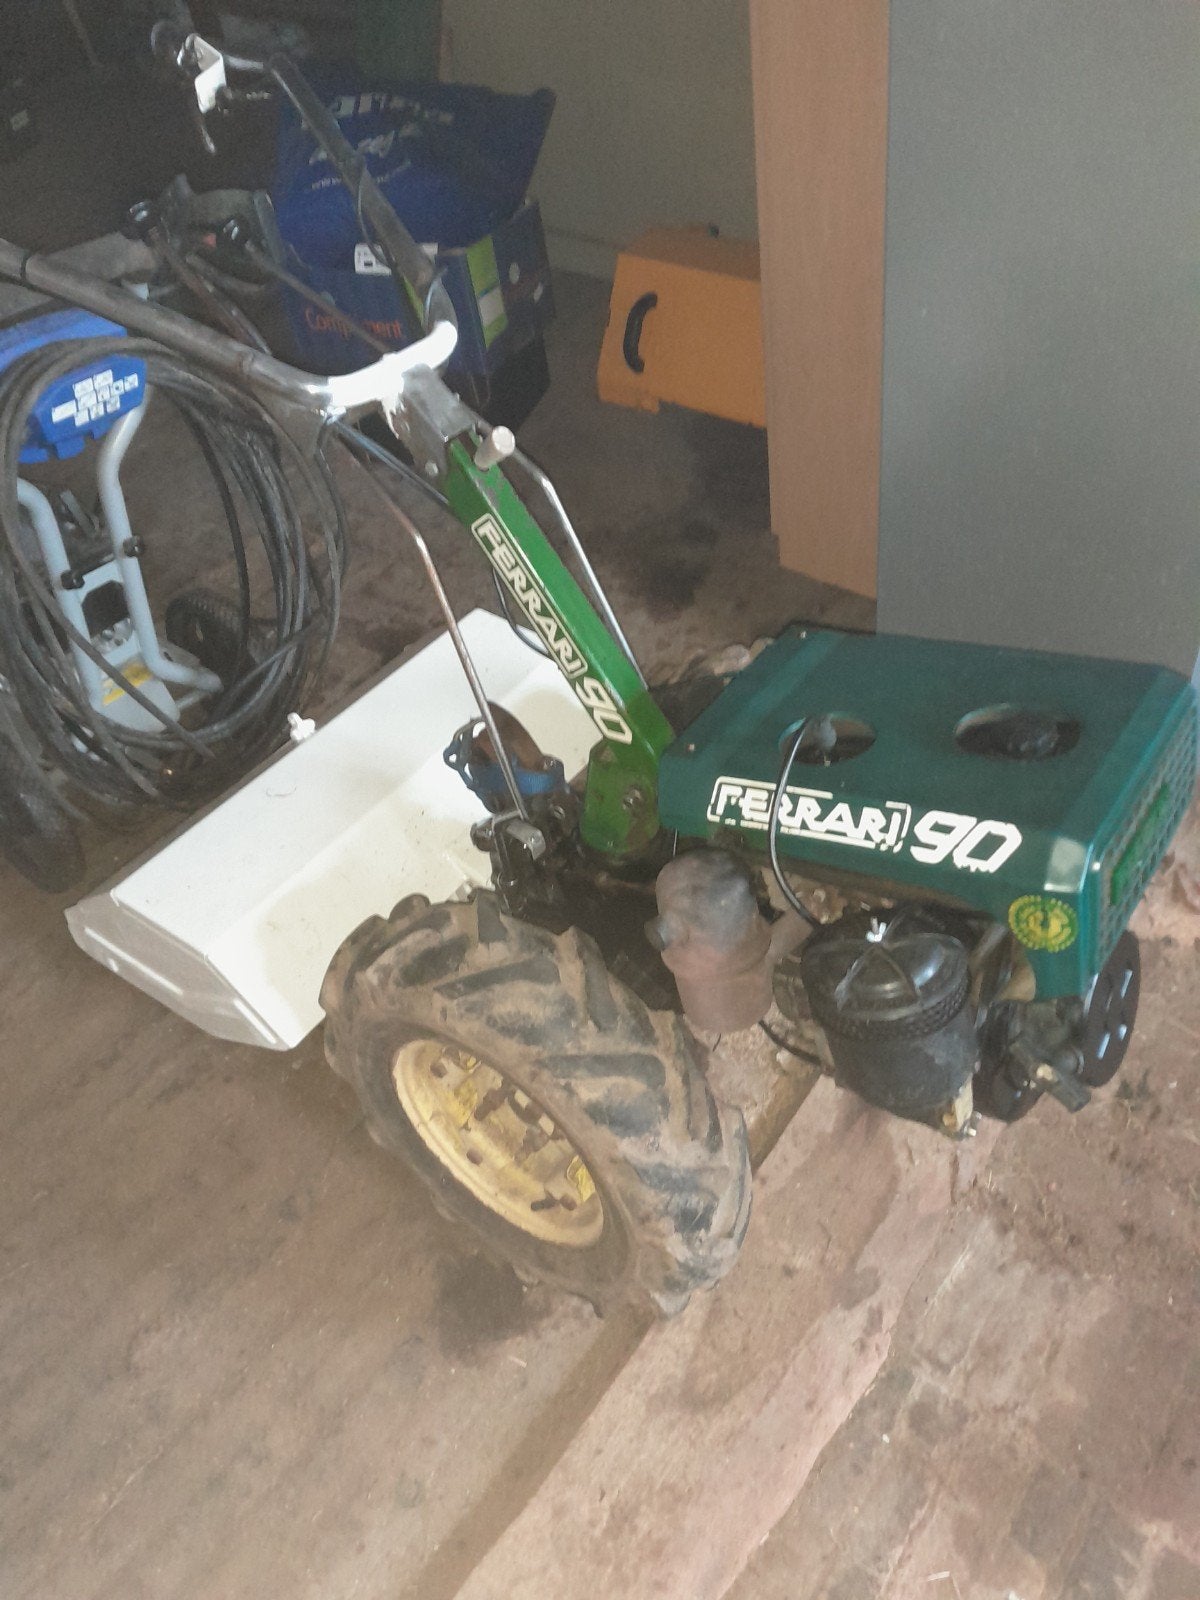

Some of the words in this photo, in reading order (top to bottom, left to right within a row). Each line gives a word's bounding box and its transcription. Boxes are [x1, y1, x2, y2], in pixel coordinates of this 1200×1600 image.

[476, 519, 584, 674] FERRARI
[575, 676, 633, 745] 90
[715, 784, 903, 848] FERRARI
[910, 810, 1023, 873] 90
